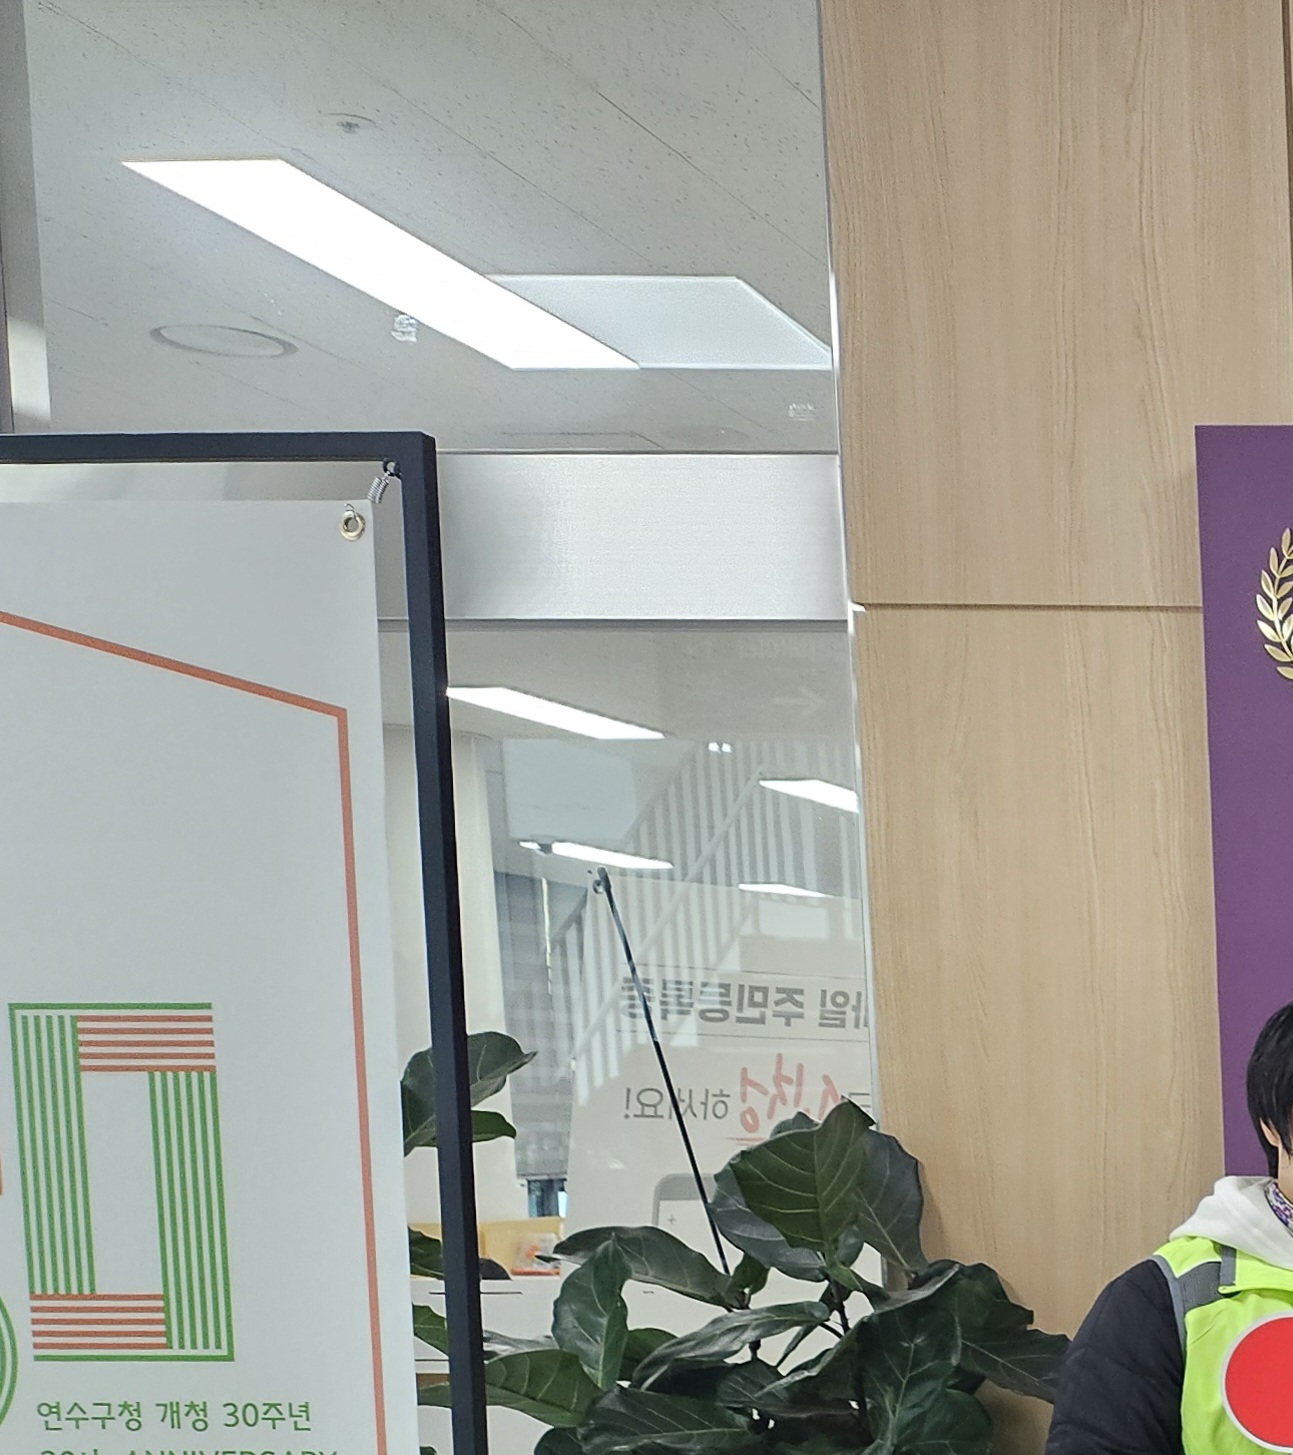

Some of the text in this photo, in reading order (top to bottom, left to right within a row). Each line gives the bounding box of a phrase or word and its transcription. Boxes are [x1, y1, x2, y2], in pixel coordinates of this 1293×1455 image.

[36, 1401, 313, 1433] 연수구청 개청 30주년
